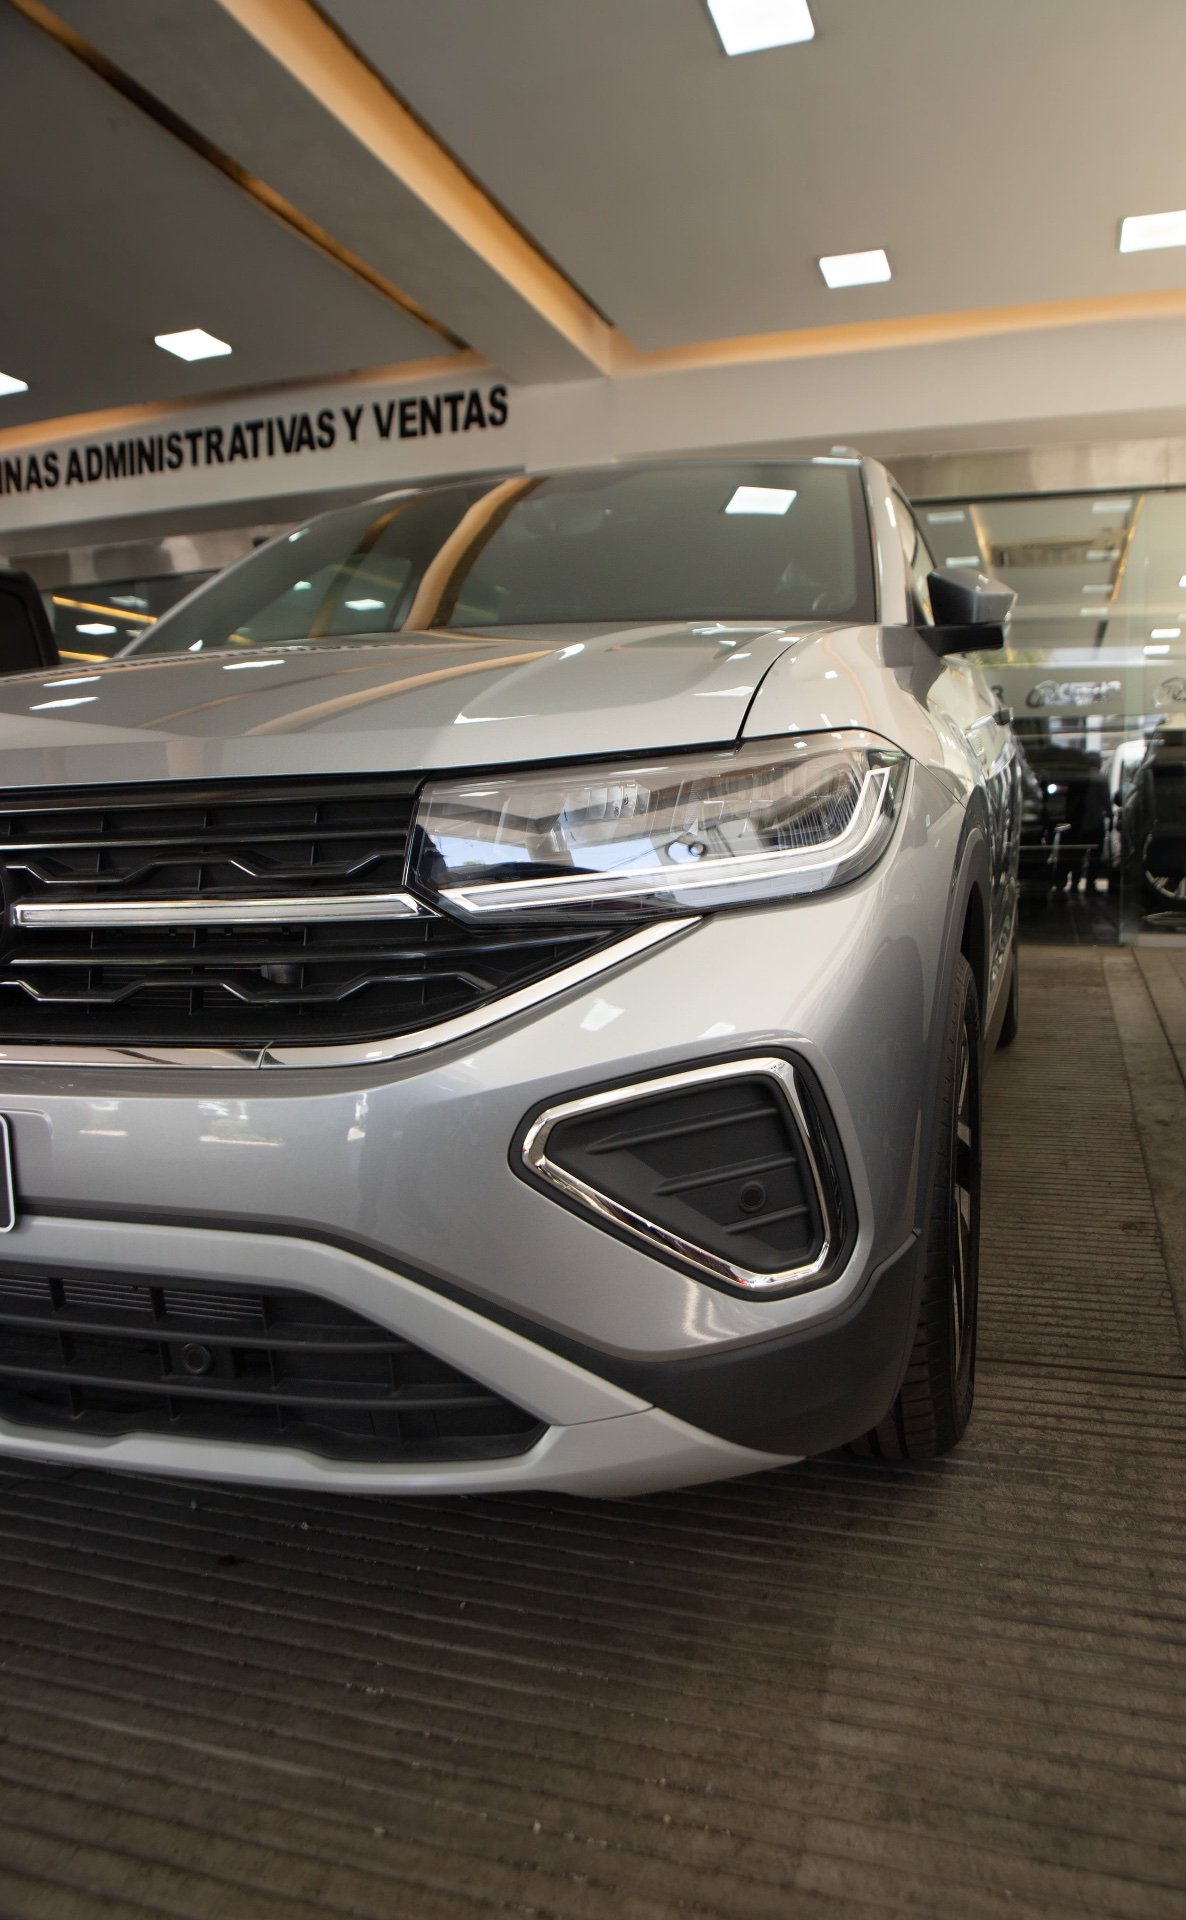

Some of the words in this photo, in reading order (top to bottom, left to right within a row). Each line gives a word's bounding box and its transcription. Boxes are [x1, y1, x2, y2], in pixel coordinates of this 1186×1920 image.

[65, 409, 335, 486] ADMINISTRATIVAS
[341, 404, 366, 442] Y
[373, 385, 508, 439] VENTAS
